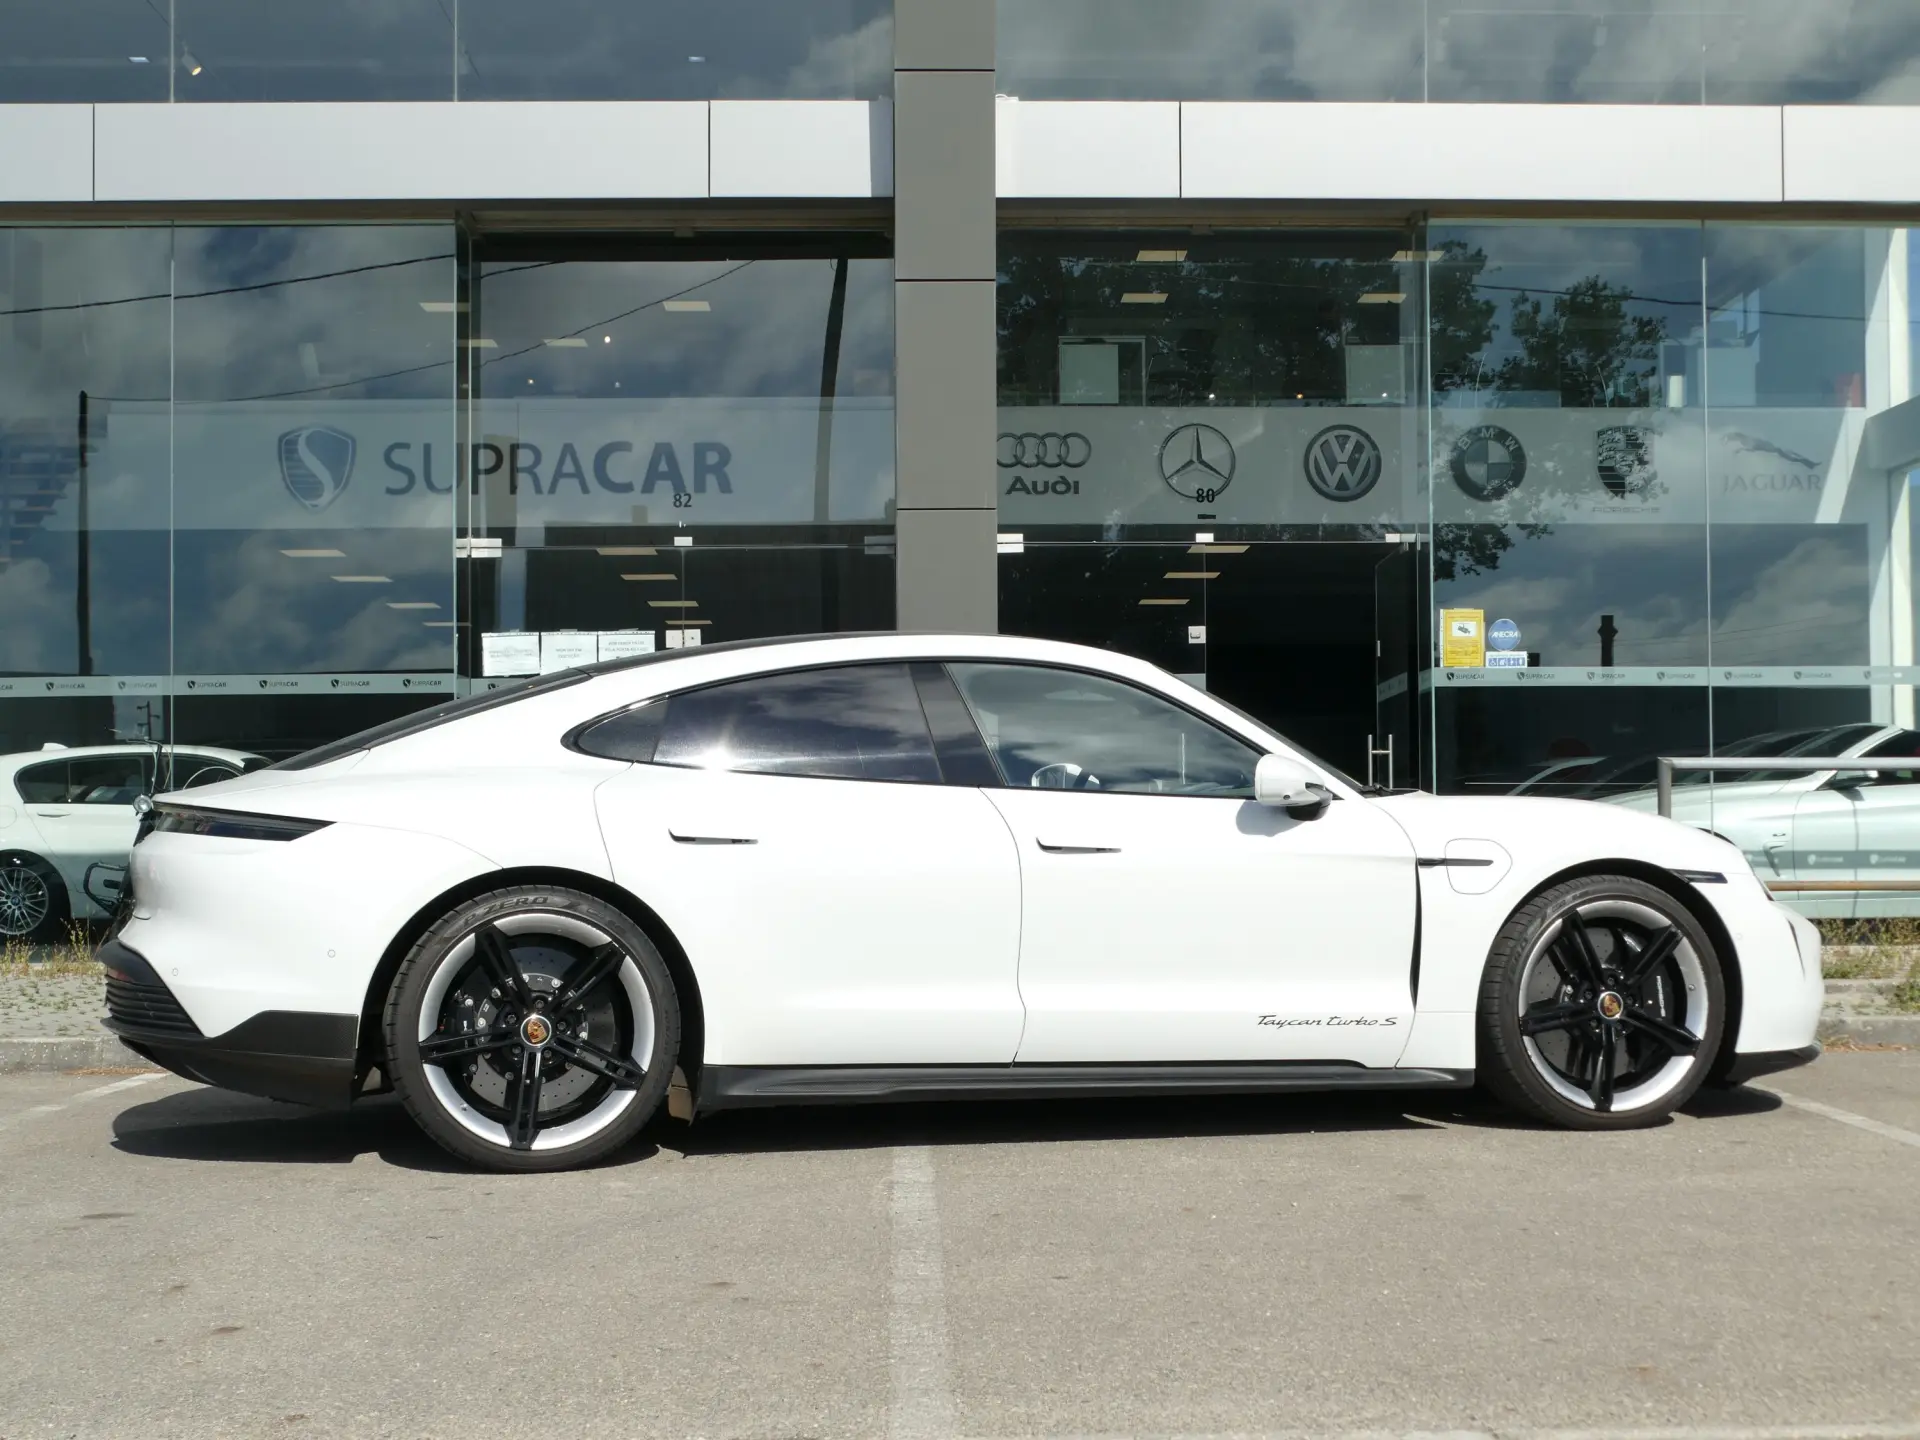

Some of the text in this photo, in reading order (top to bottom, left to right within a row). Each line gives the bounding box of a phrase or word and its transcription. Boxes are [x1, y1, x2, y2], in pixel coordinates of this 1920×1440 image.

[383, 441, 734, 495] SUPRACAR
[1005, 475, 1080, 496] Audi
[1723, 474, 1822, 494] JAGUAR
[672, 493, 693, 508] 82
[1196, 487, 1216, 503] 80
[483, 896, 549, 913] ZERO
[1257, 1014, 1397, 1029] Taycan turbo S
